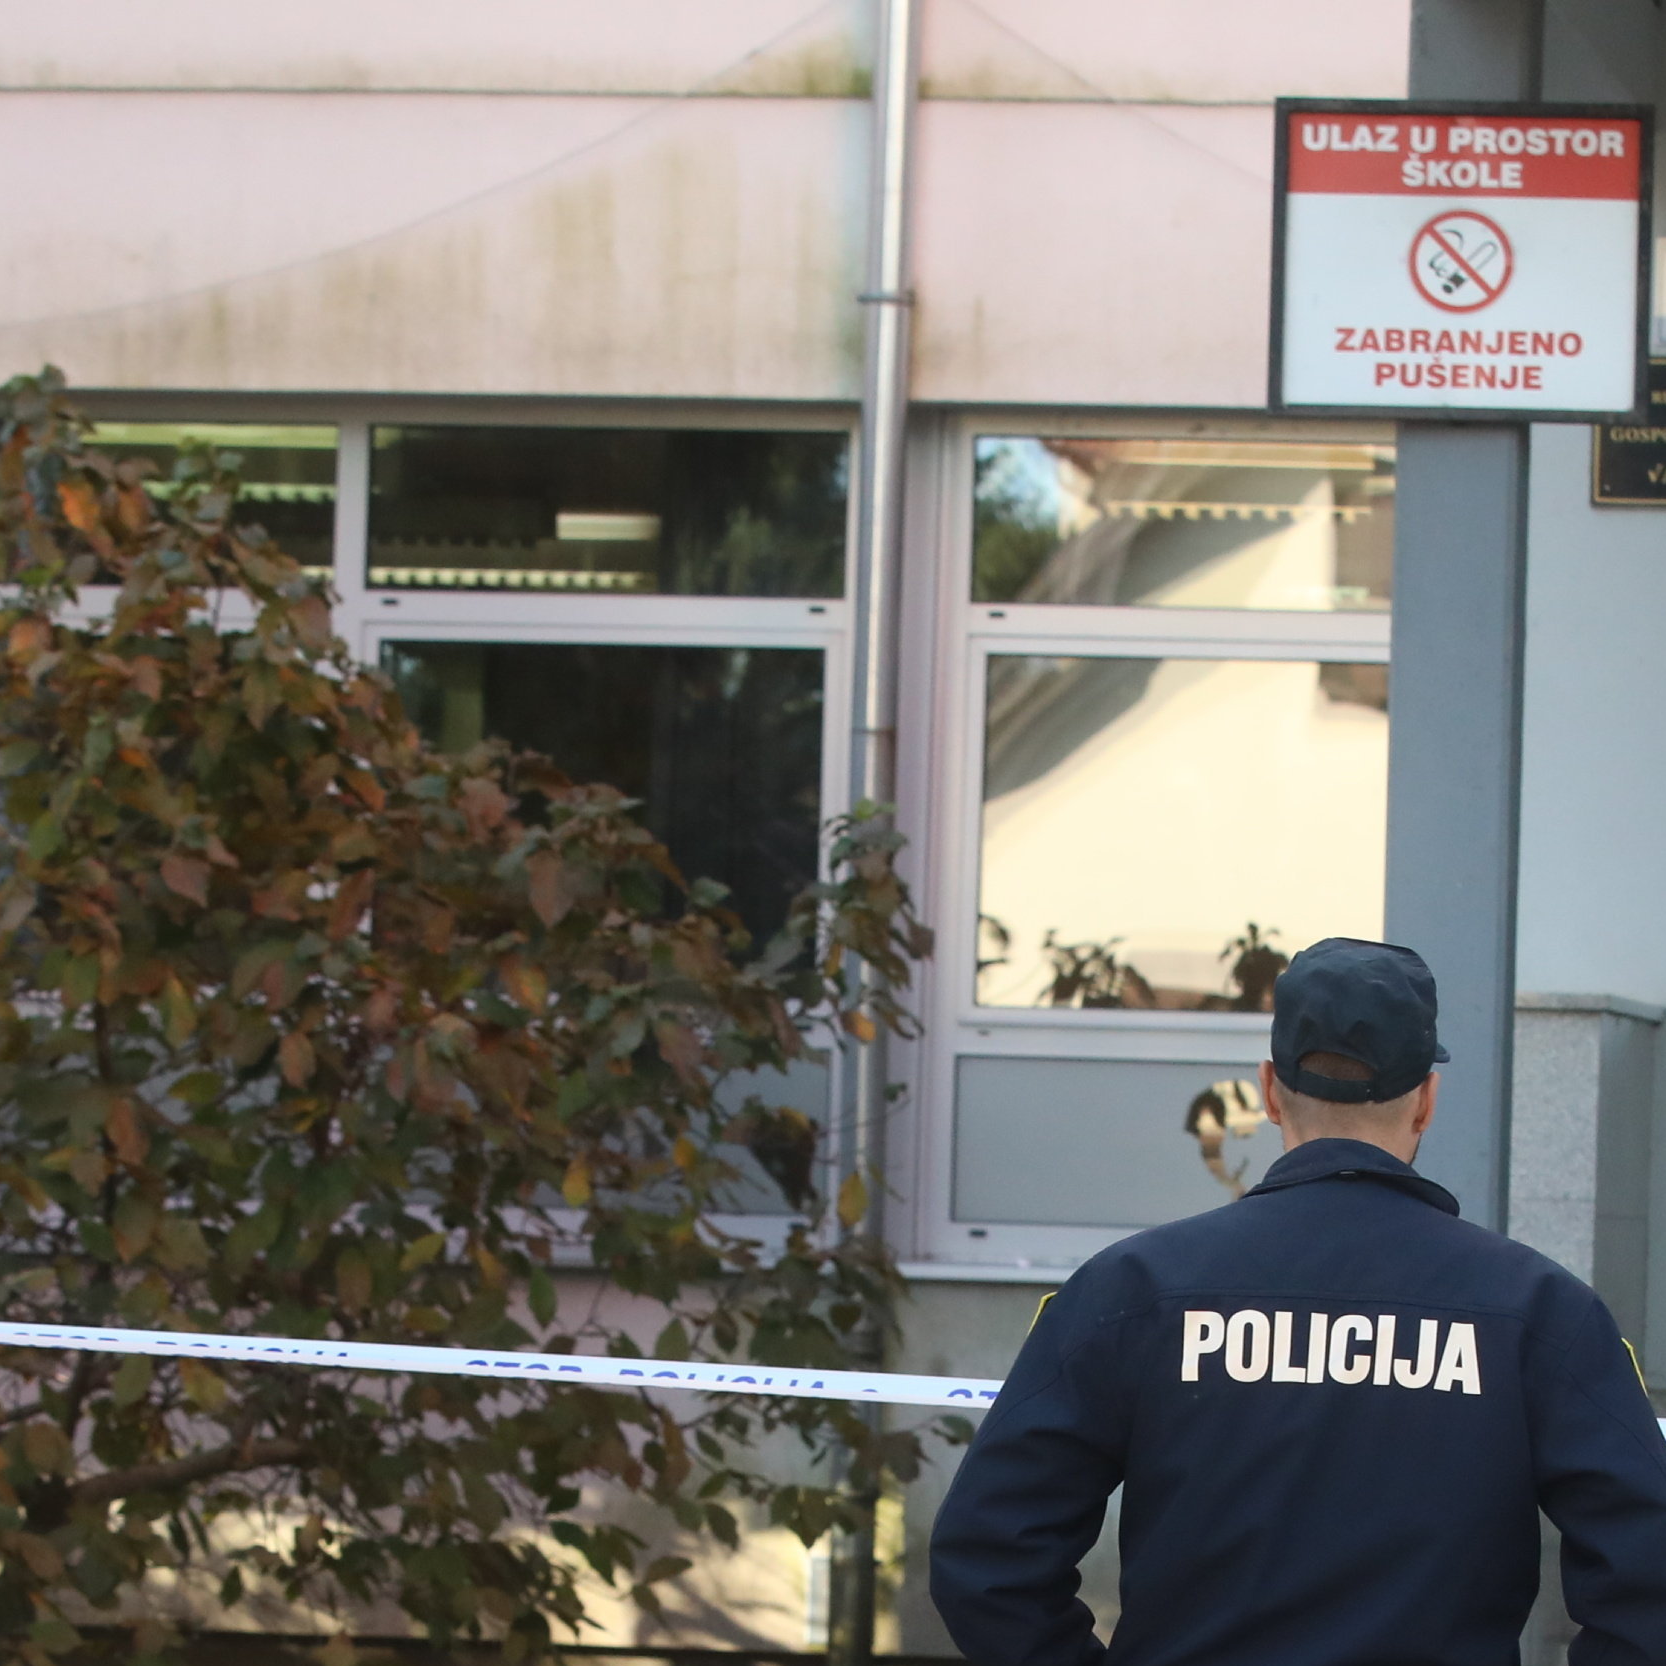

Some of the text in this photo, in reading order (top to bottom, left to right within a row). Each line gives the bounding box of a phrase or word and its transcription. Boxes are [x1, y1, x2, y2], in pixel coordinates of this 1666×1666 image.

[1302, 123, 1625, 157] ULAZ U PROSTOR
[1401, 153, 1524, 189] ŠKOLE
[1334, 327, 1583, 356] ZABRANJENO
[1374, 358, 1543, 391] PUŠENJE
[1180, 1309, 1482, 1396] POLICIJA
